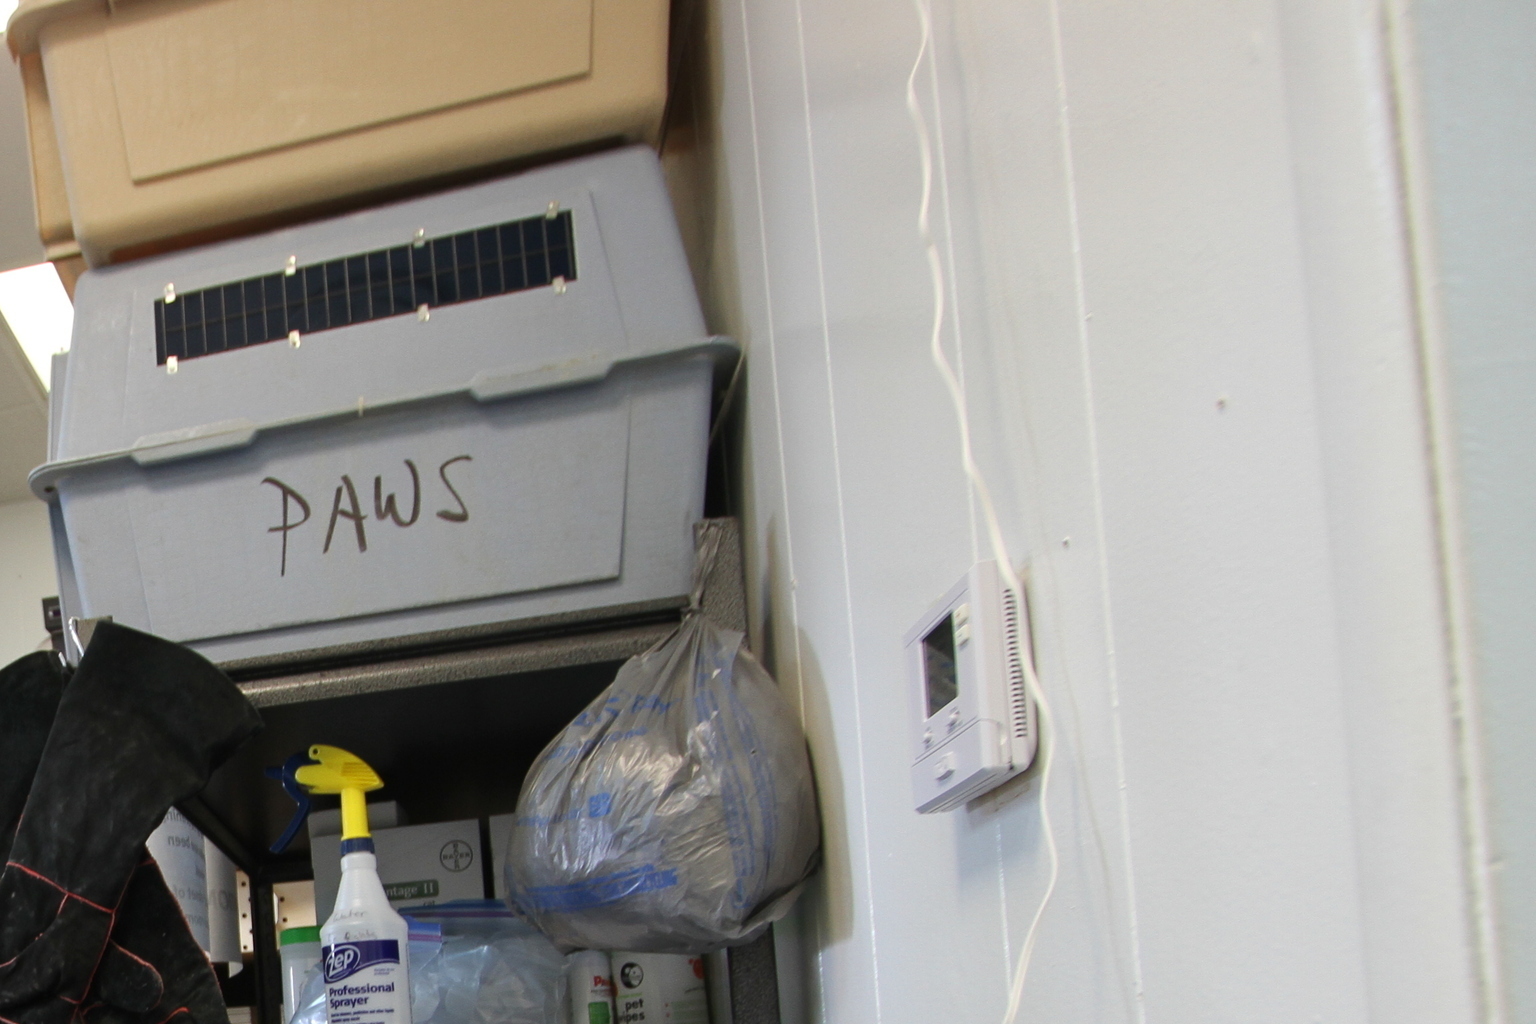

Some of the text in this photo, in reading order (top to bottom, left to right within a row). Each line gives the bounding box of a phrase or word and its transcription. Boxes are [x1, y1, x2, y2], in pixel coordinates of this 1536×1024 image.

[261, 454, 473, 577] PAWS
[386, 883, 419, 898] ntage
[329, 982, 396, 997] Professional
[330, 996, 370, 1010] Sprayer
[625, 998, 645, 1012] pet
